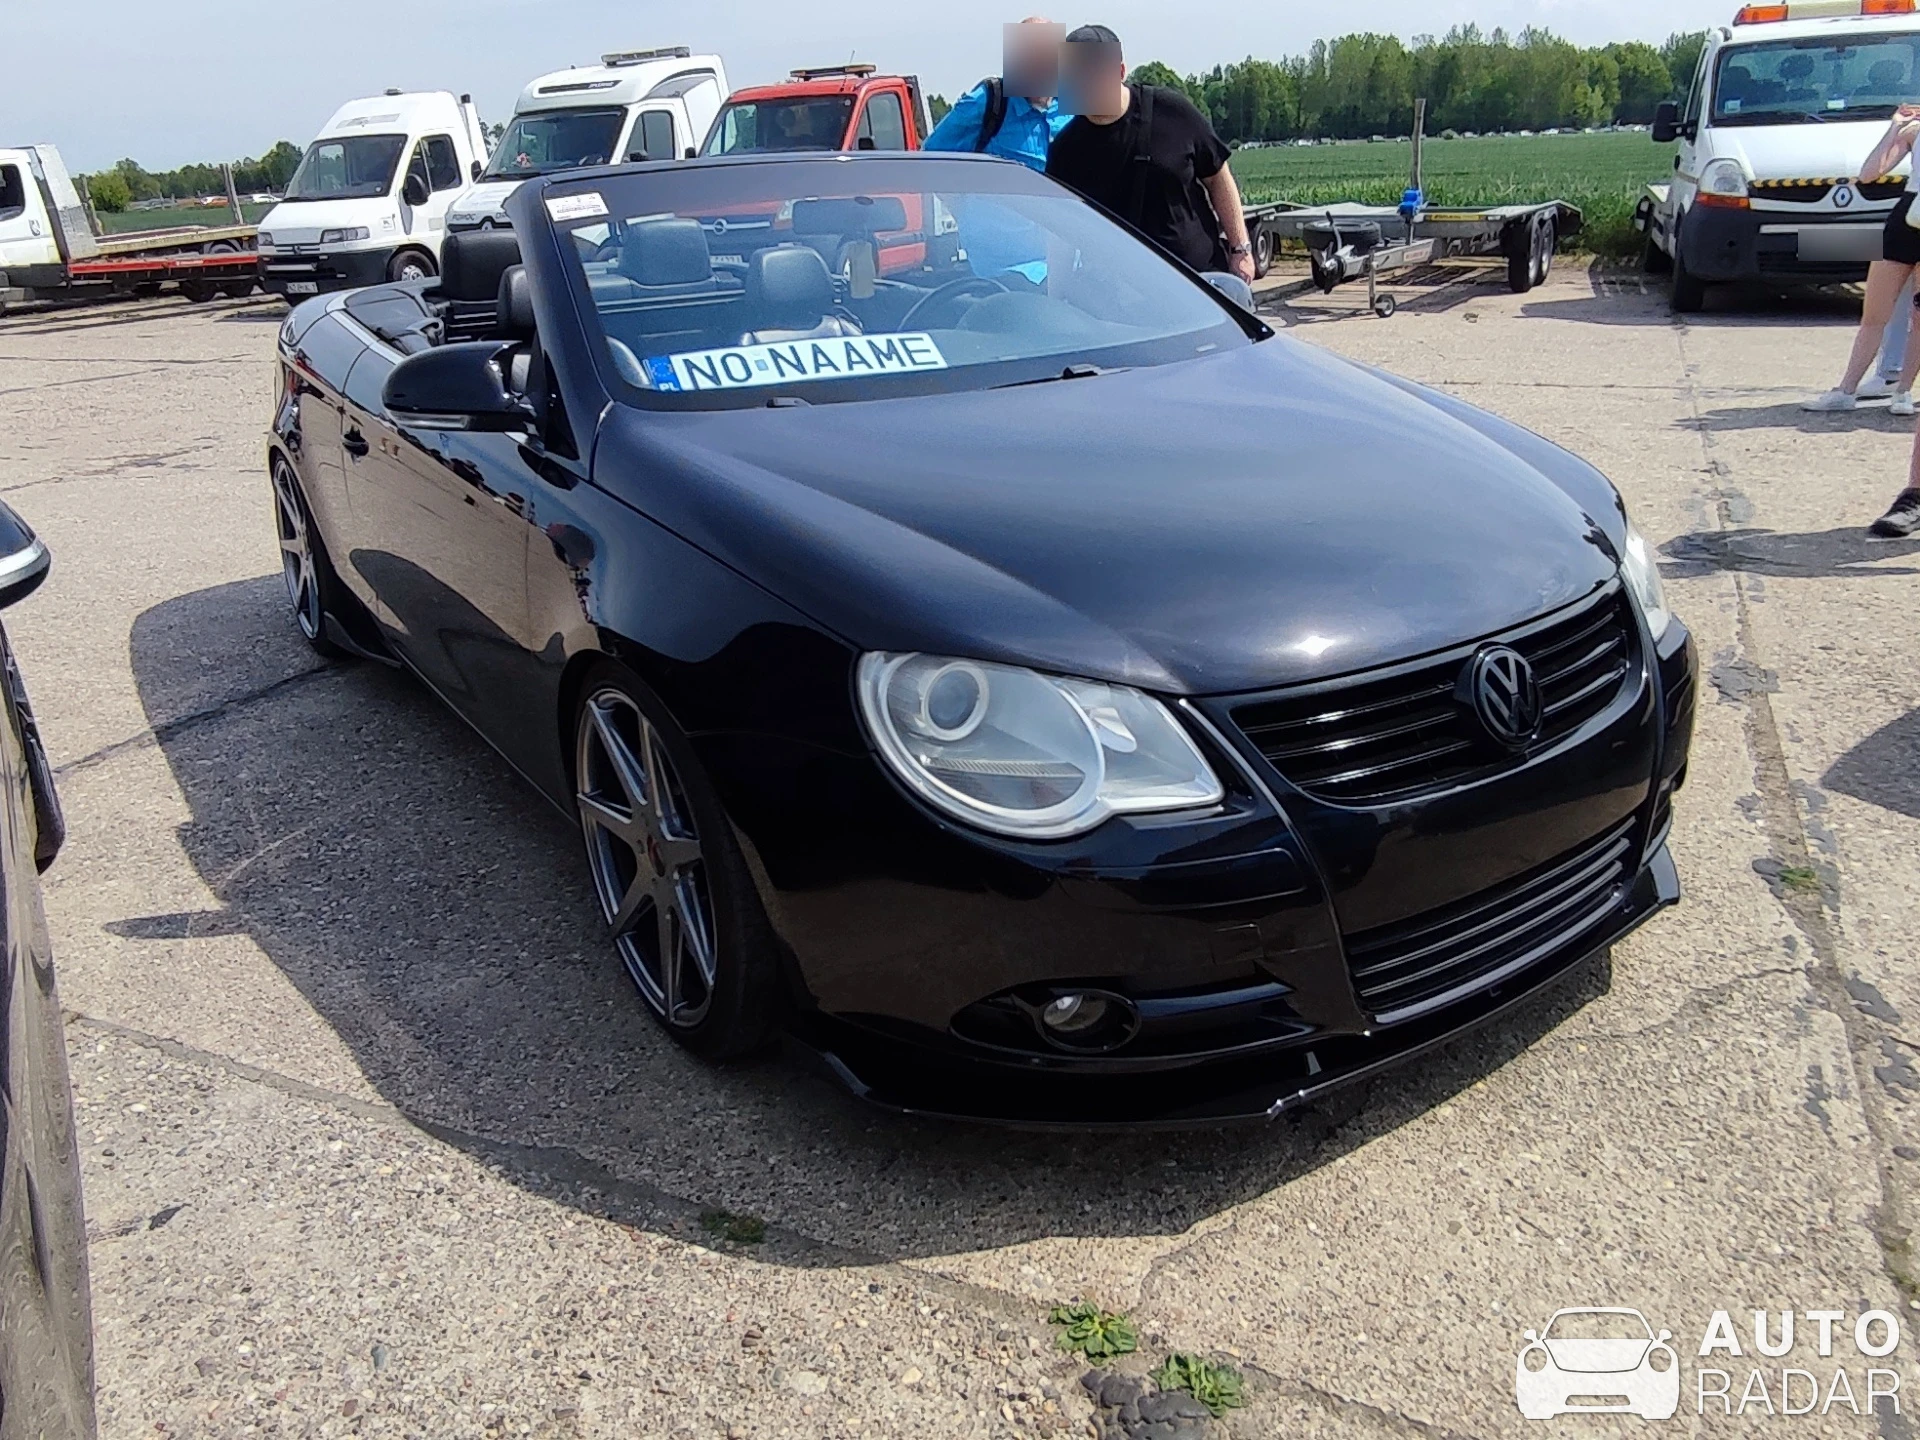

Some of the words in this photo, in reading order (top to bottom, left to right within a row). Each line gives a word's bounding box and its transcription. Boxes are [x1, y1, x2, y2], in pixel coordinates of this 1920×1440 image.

[682, 353, 752, 390] NO
[767, 337, 938, 377] NAAME
[659, 382, 681, 392] PL
